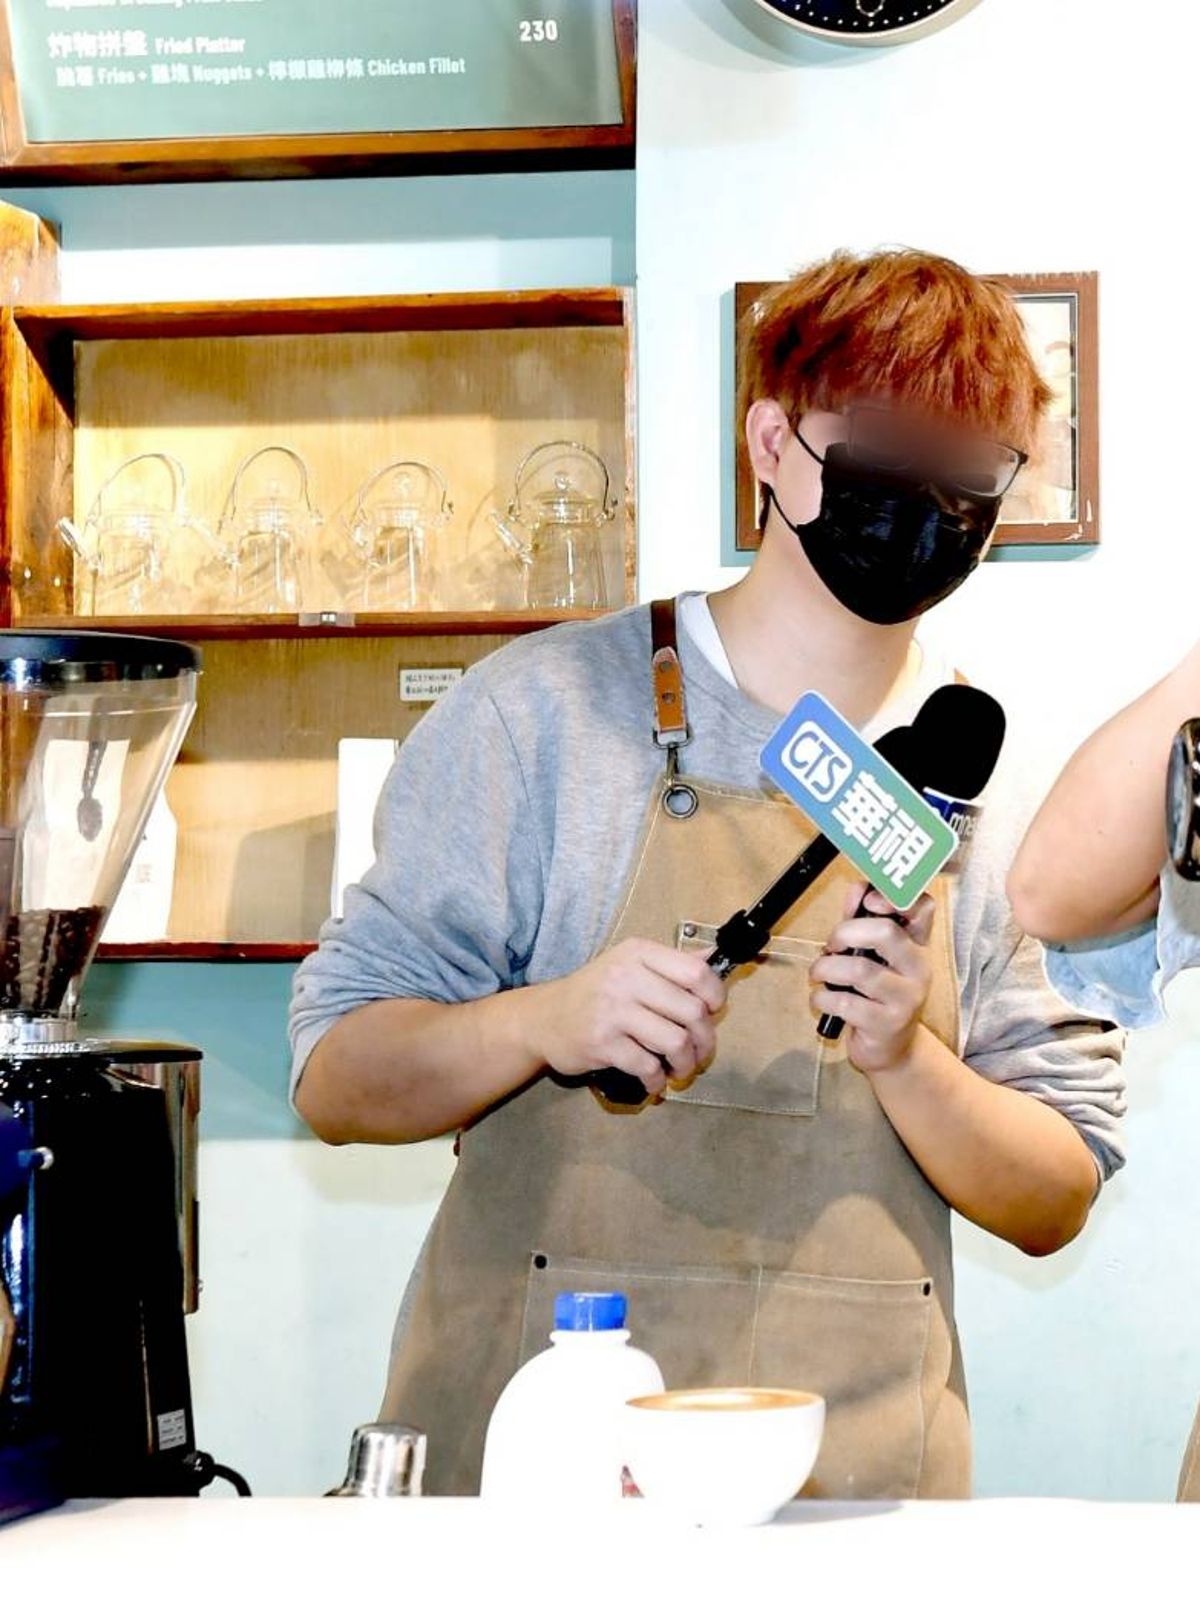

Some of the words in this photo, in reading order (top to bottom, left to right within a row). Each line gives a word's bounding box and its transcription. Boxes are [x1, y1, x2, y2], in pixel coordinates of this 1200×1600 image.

[519, 20, 558, 41] 230
[155, 37, 194, 54] Fried
[367, 59, 426, 76] Chicken
[788, 730, 848, 796] CTS
[831, 770, 934, 889] 華視
